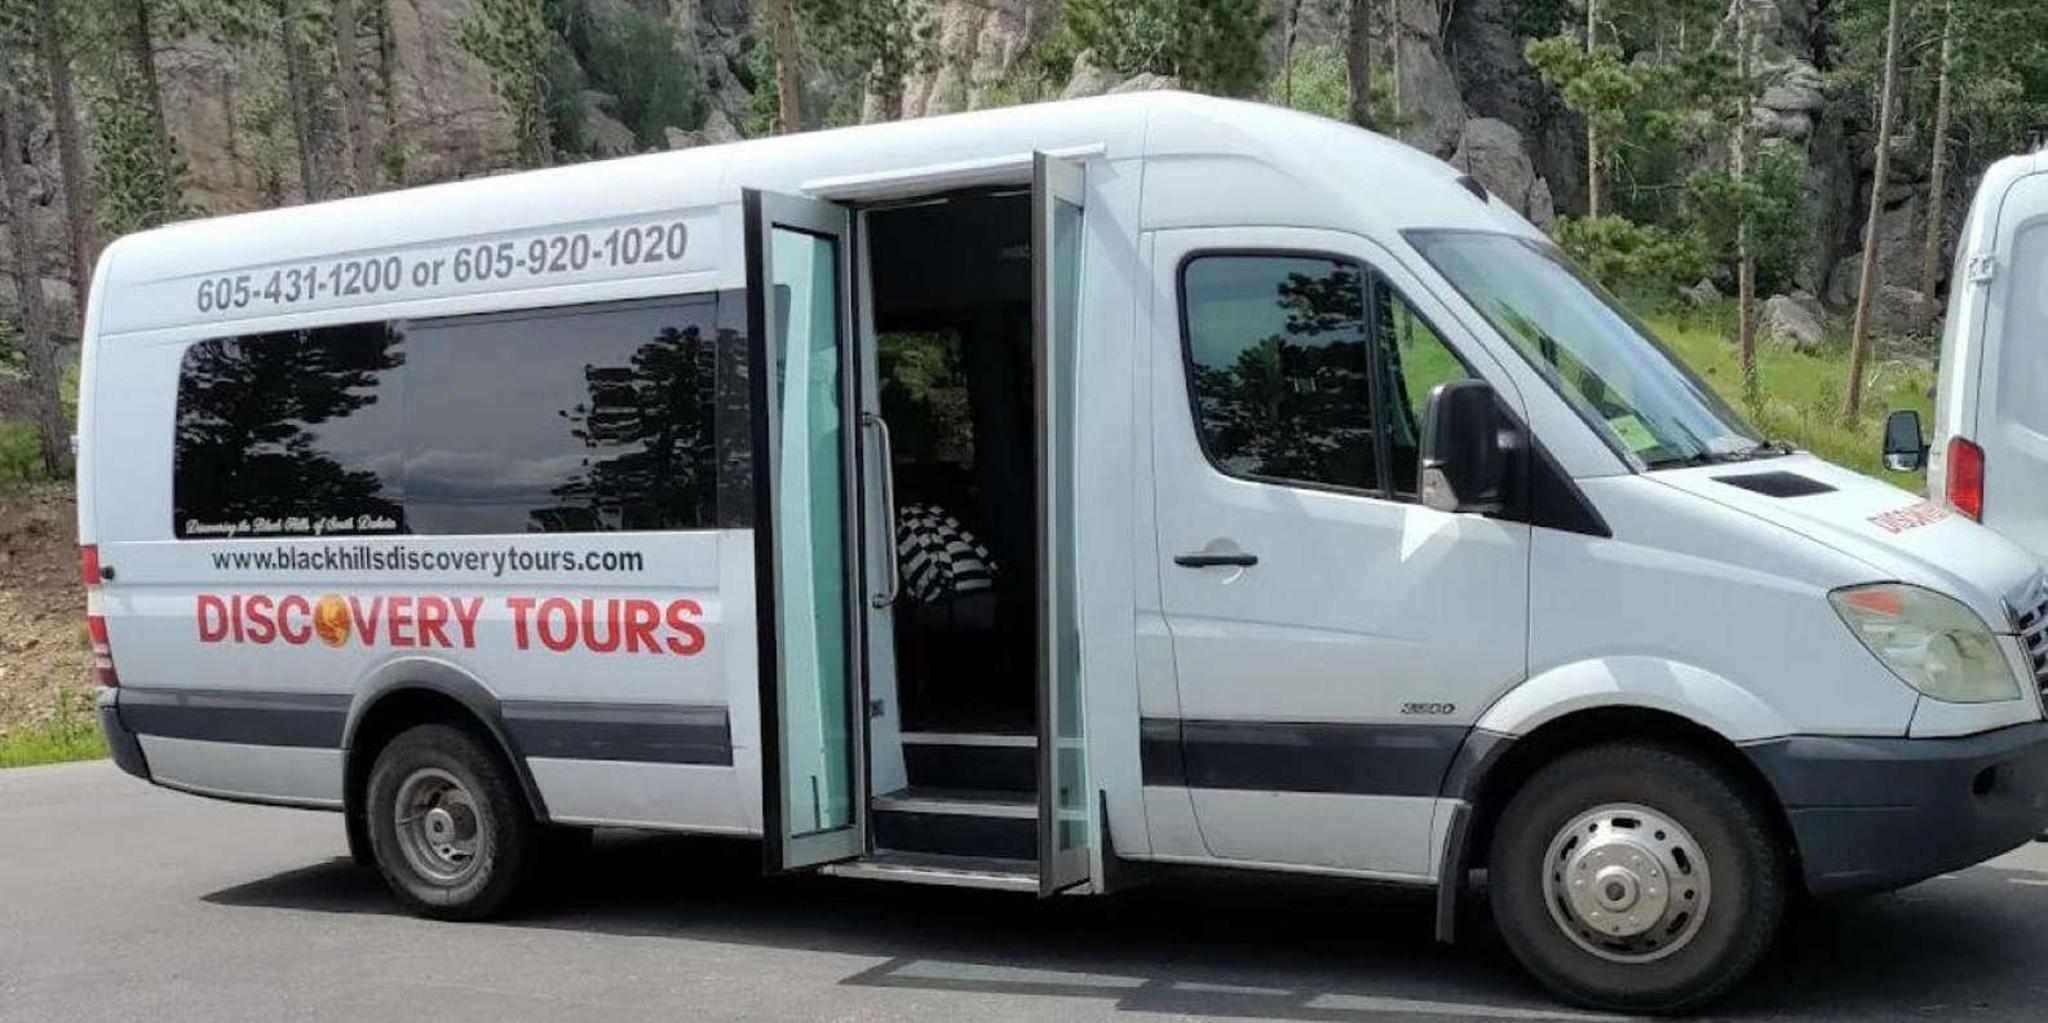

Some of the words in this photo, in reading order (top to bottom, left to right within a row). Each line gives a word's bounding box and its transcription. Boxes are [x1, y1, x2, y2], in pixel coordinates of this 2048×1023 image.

[197, 256, 402, 313] 605-431-1200
[412, 260, 445, 287] or
[453, 222, 688, 283] 605-920-1020
[212, 546, 644, 577] www.blackhillsdiscoverytours.com
[506, 597, 706, 656] TOURS
